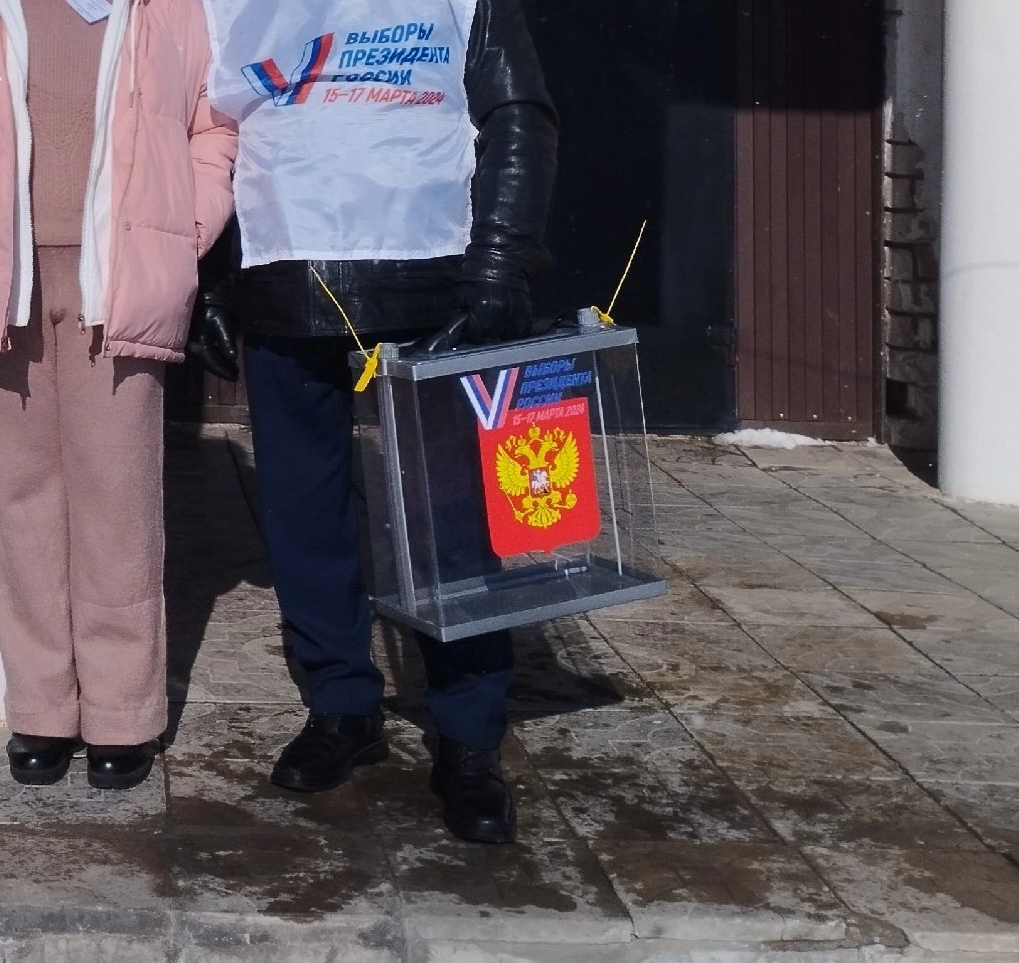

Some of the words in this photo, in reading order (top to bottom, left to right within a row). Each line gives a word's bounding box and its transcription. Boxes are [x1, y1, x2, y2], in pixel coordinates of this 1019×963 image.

[345, 22, 434, 46] ВЫБОРЫ
[338, 46, 451, 69] ПРЕЗИДЕНТА
[366, 88, 418, 105] МАРТА
[416, 91, 447, 105] 2024
[524, 358, 575, 378] ВЫБОРЫ
[520, 371, 591, 395] ПРЕЗИДЕНТА
[516, 392, 562, 410] РОССИИ
[536, 406, 565, 421] МАРТА
[565, 402, 585, 418] 2024
